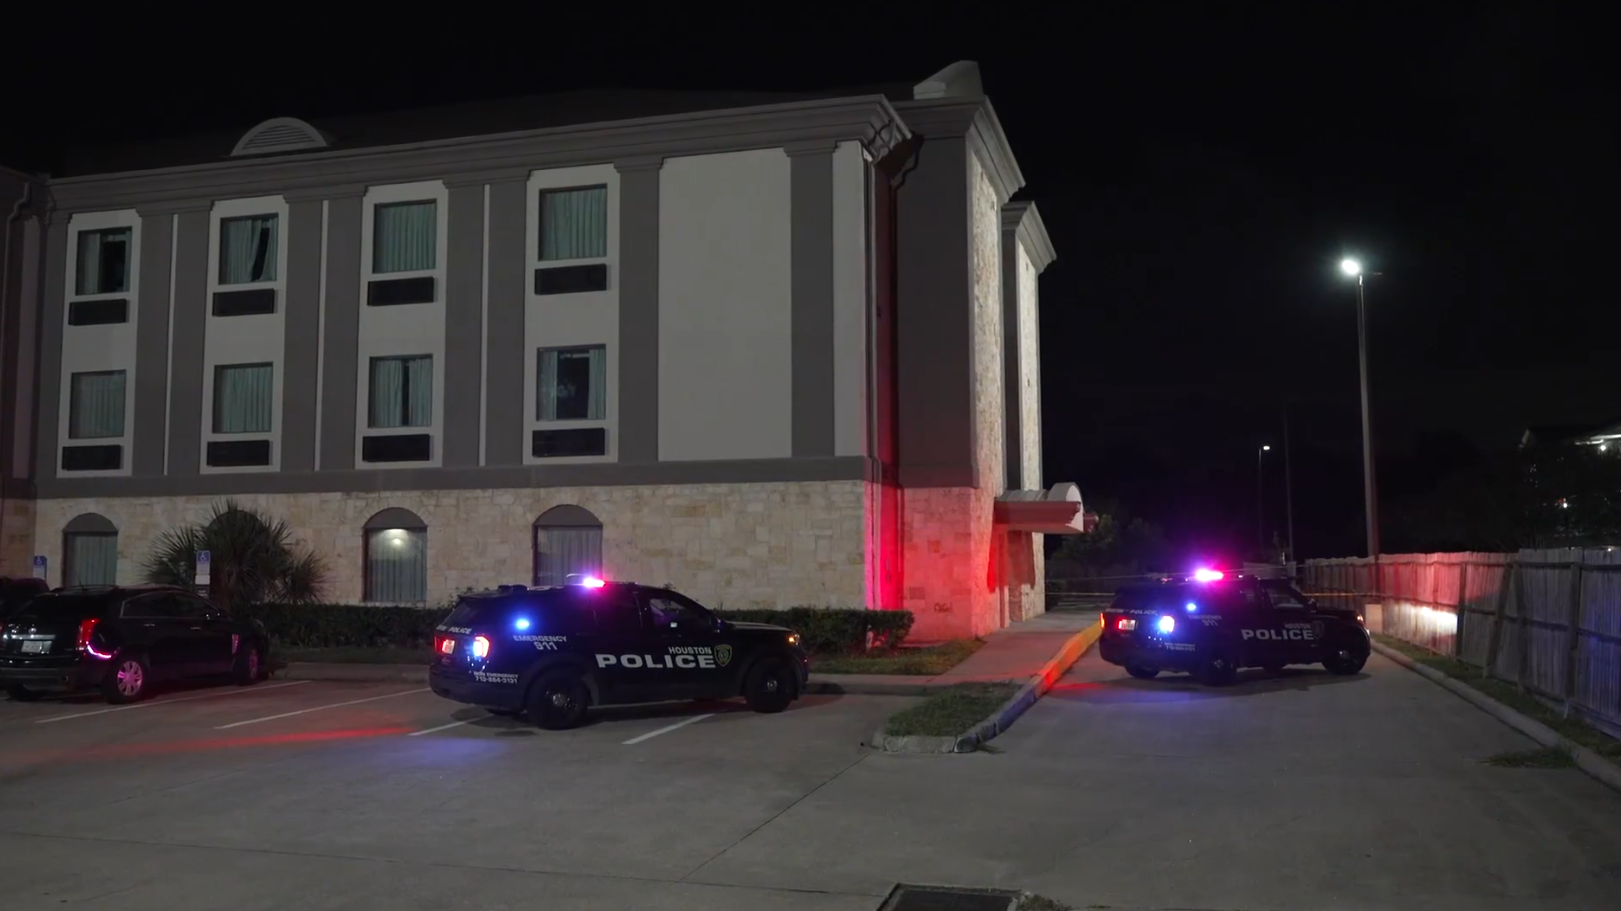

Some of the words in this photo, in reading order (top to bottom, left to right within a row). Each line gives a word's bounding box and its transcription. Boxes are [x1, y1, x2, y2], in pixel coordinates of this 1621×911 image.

[1241, 629, 1314, 640] POLICE
[534, 641, 558, 650] 911
[668, 647, 712, 655] HOUSTON
[595, 654, 716, 668] POLICE
